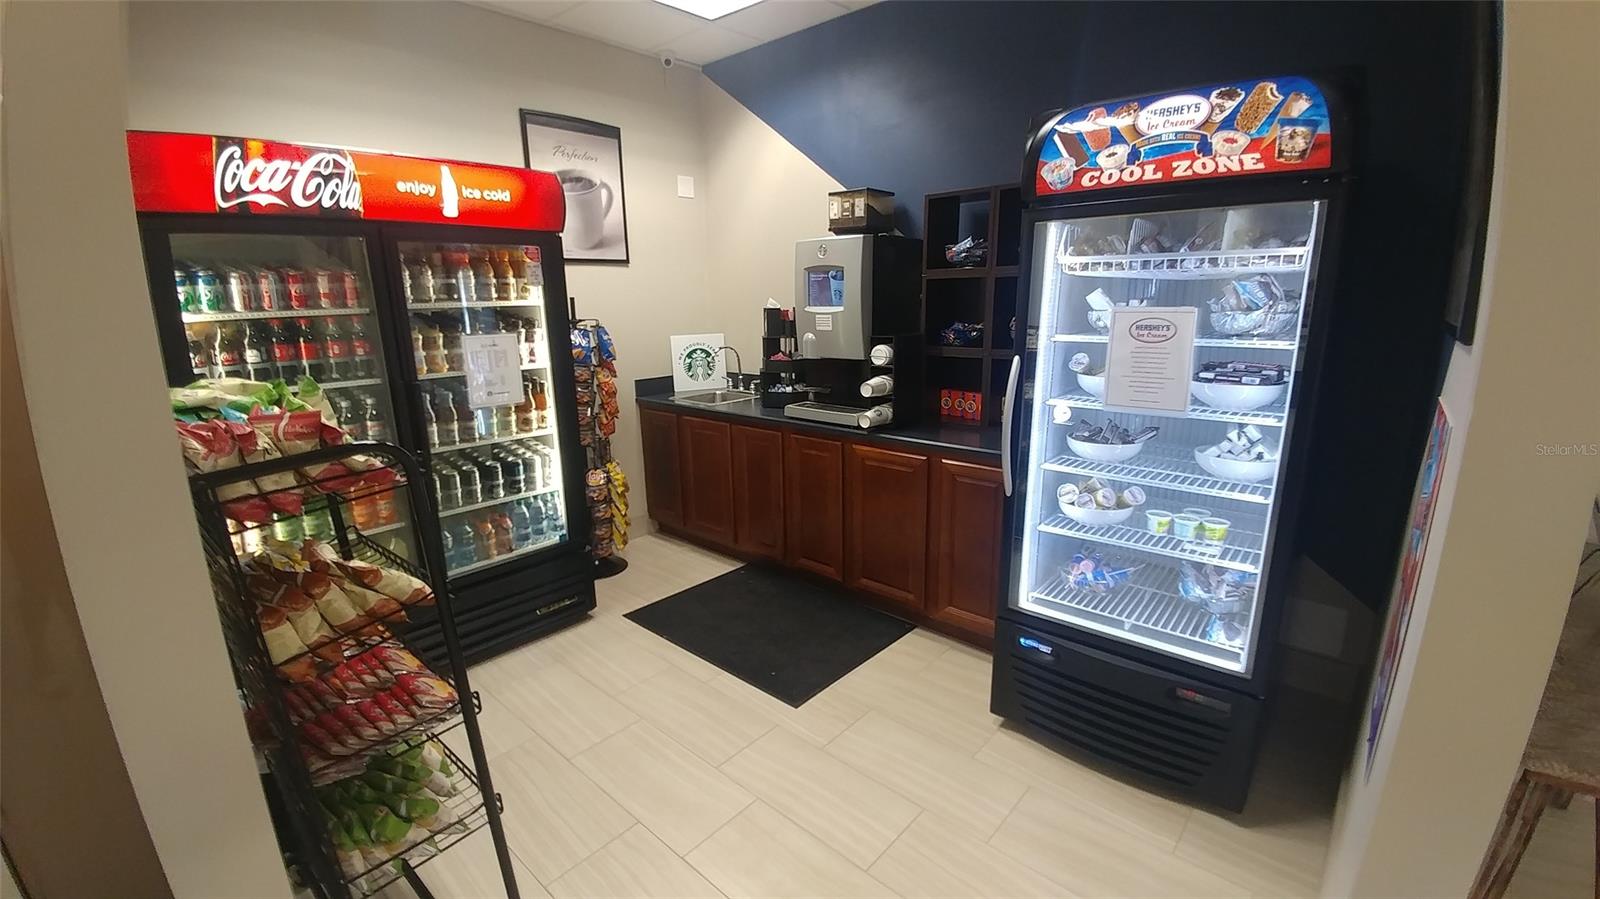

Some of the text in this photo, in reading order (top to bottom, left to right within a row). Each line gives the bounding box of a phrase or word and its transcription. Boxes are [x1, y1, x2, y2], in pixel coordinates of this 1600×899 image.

[1163, 119, 1196, 129] Cream
[215, 145, 362, 212] Coca-Cola
[1081, 153, 1266, 187] COOL ZONE
[396, 180, 437, 197] enjoy
[483, 189, 511, 202] cold
